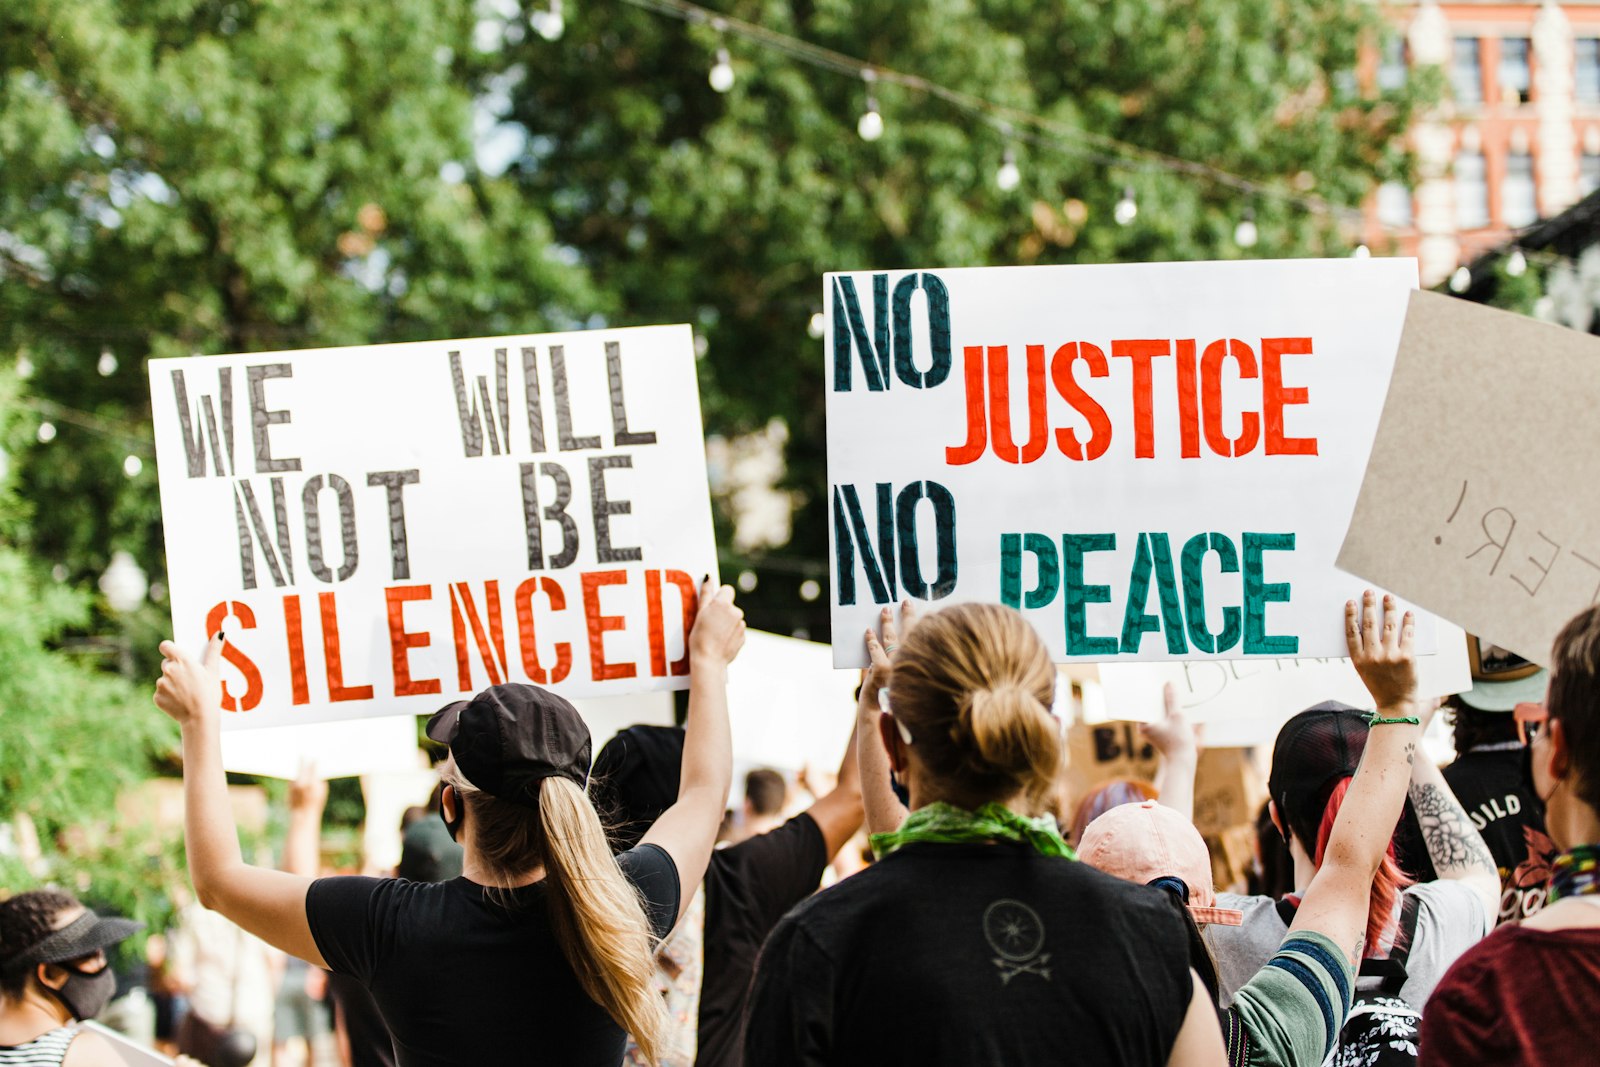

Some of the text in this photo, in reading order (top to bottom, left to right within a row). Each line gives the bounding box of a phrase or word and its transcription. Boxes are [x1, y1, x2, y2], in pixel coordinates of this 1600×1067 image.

[171, 341, 658, 478] WE WILL
[833, 272, 1319, 465] NO JUSTICE
[235, 454, 644, 590] NOT BE
[834, 480, 1300, 657] NO PEACE
[205, 569, 692, 712] SILENCED
